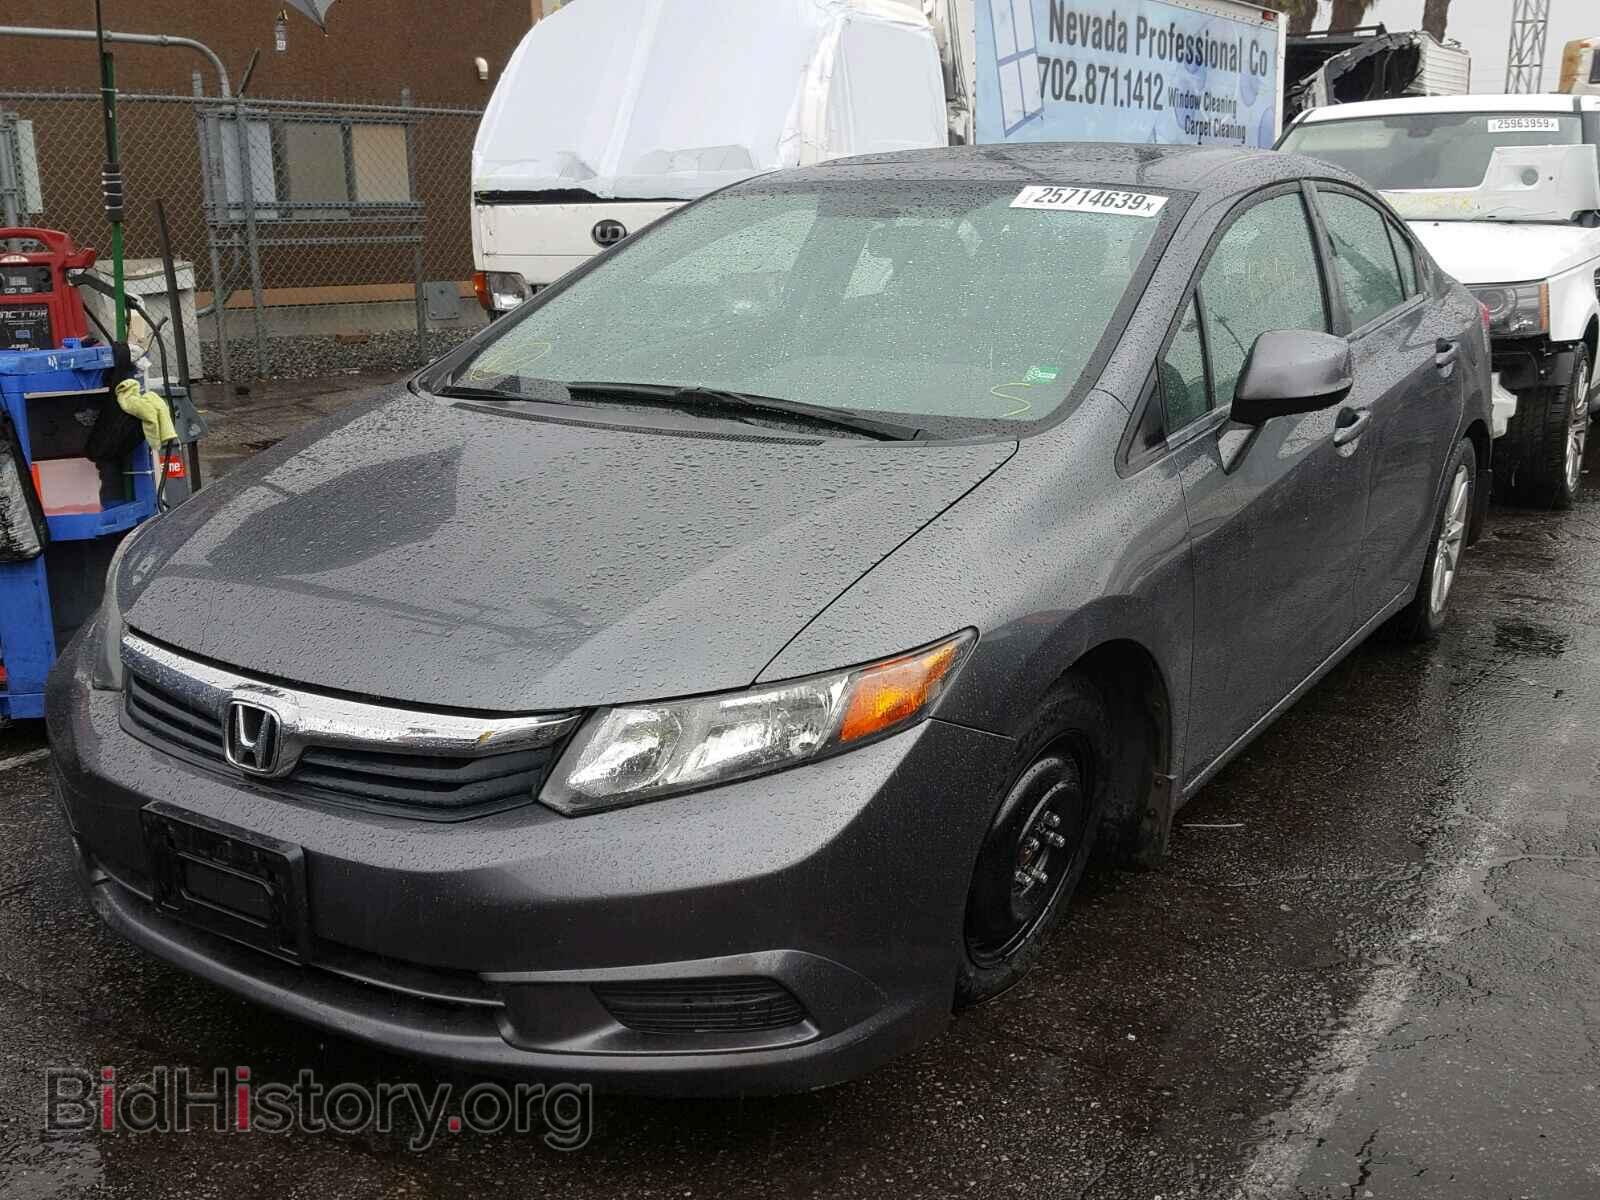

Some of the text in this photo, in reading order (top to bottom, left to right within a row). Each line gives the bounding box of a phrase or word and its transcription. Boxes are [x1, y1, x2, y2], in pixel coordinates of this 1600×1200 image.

[1049, 0, 1268, 77] Nevada Professional Co
[1036, 55, 1164, 111] 702.871.1412
[1168, 86, 1237, 119] Window Cleaning
[1184, 114, 1246, 145] Carpet Cleaning
